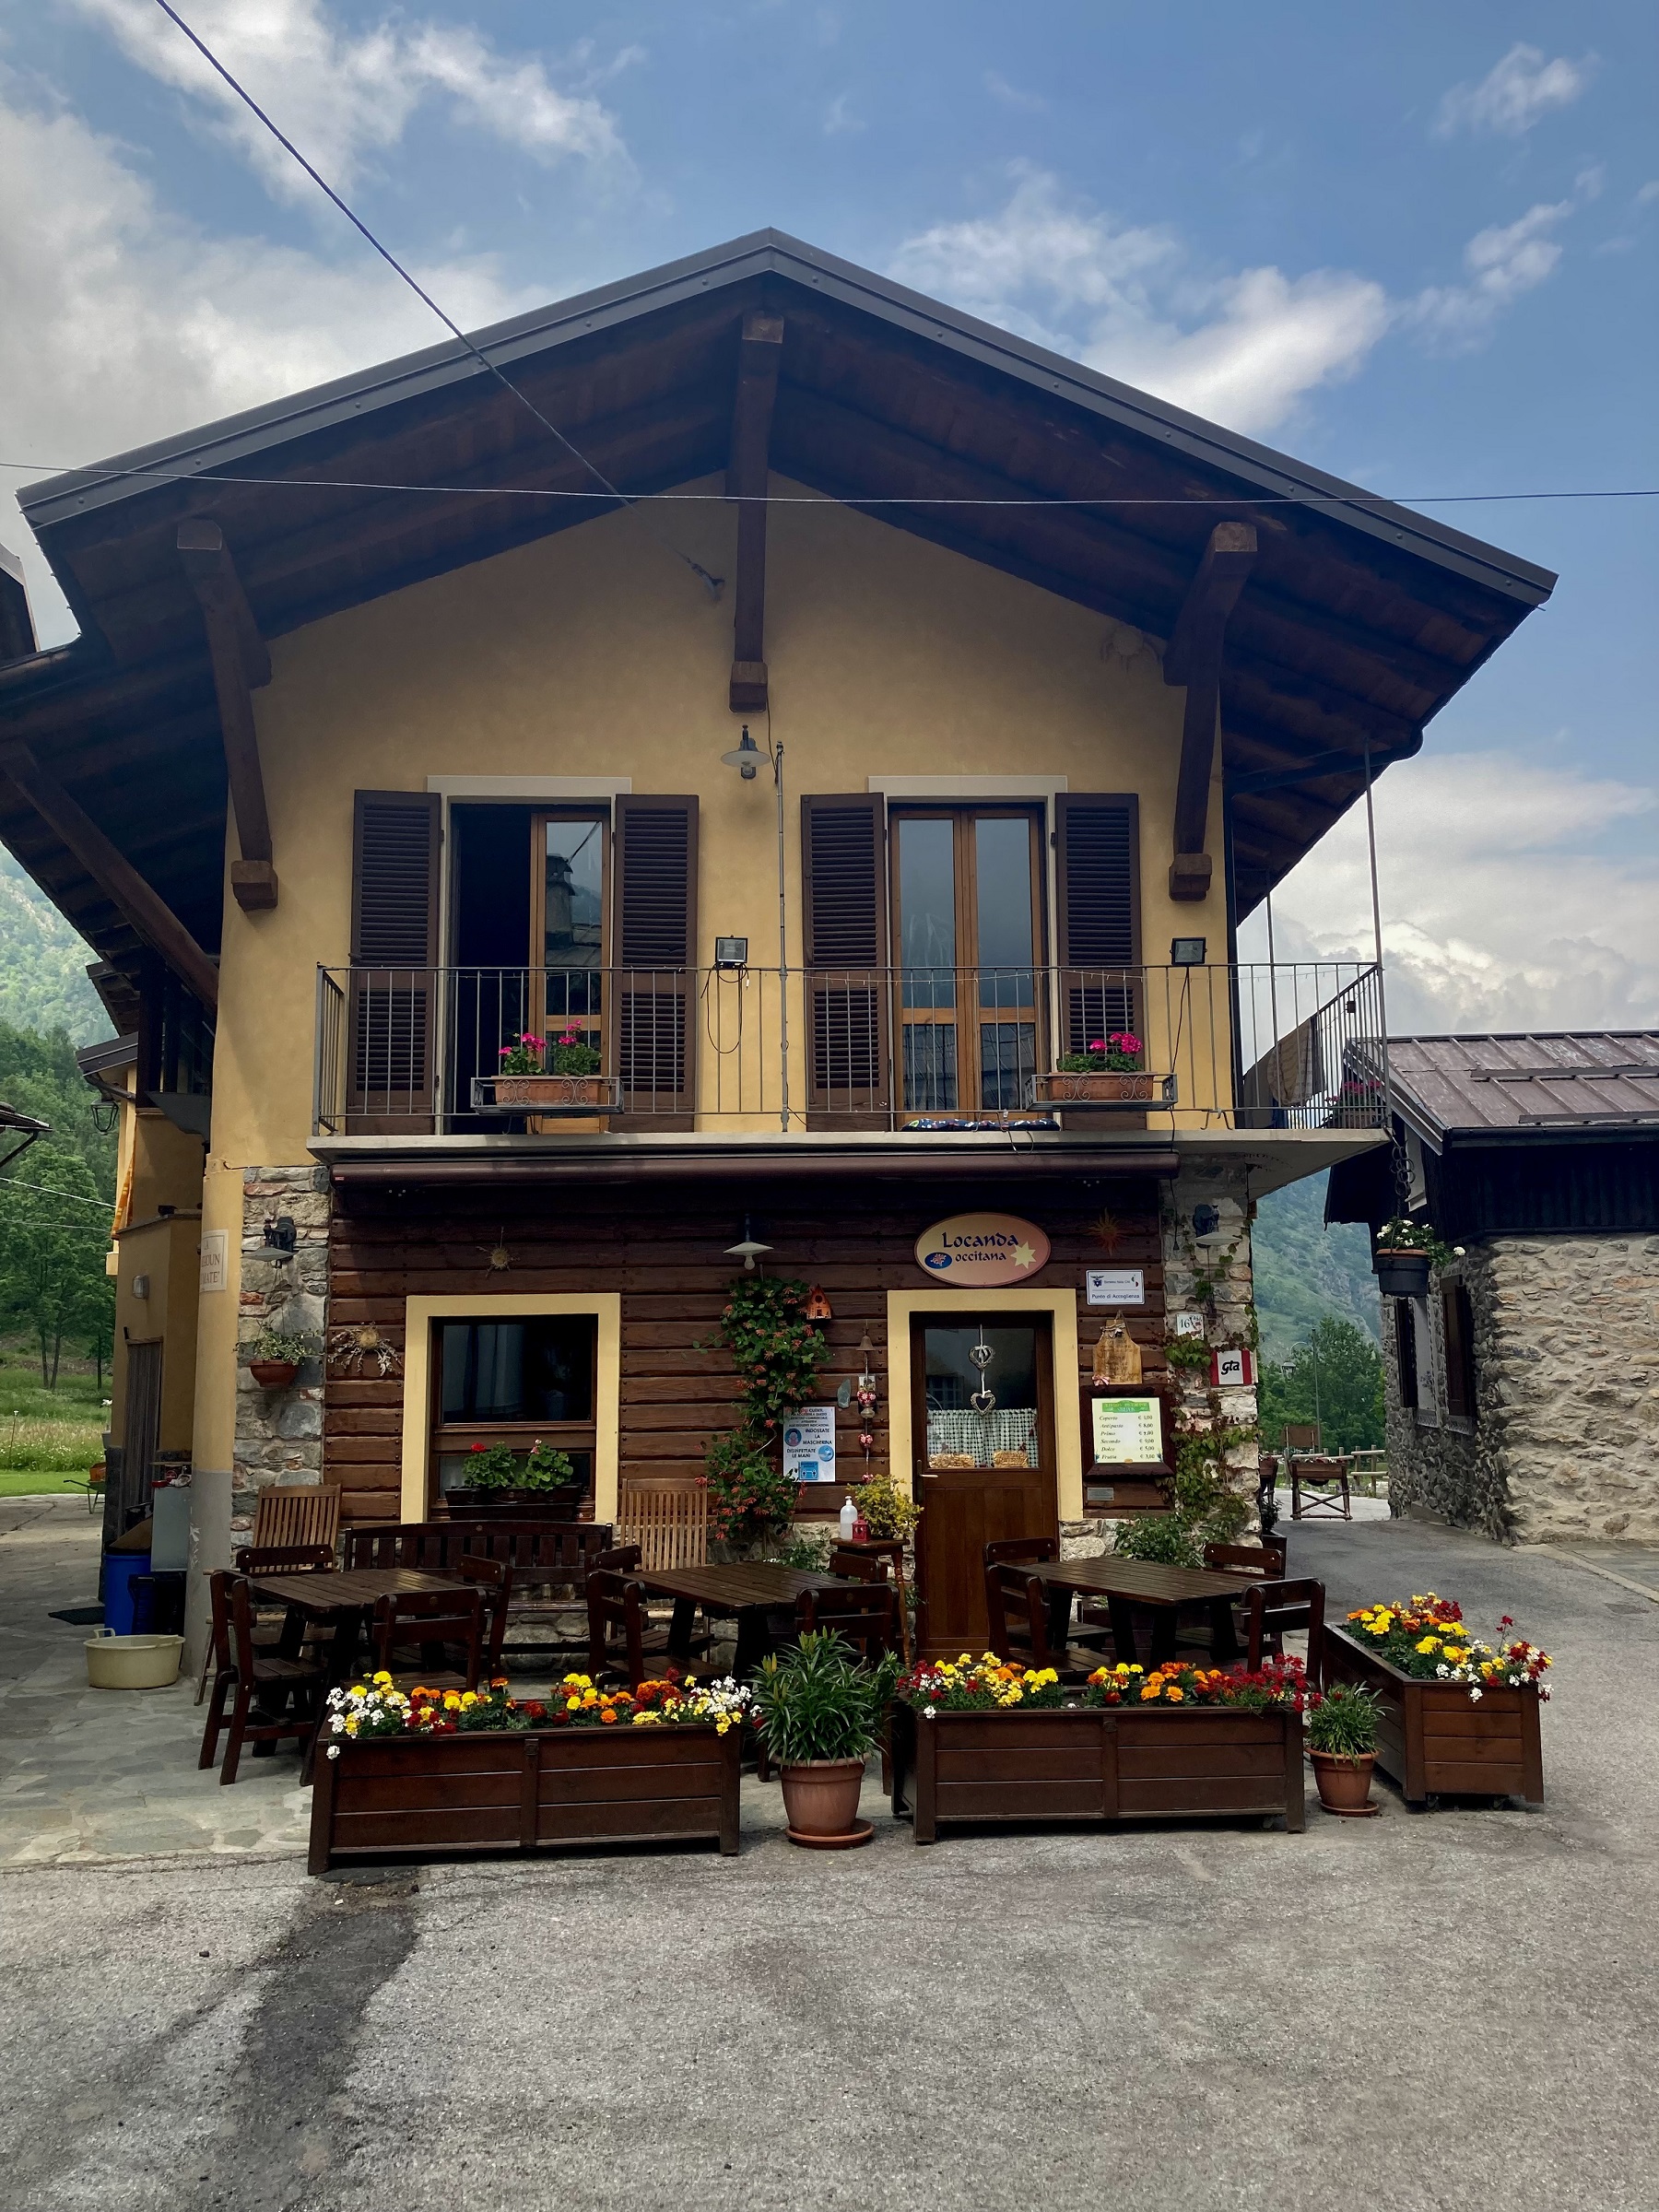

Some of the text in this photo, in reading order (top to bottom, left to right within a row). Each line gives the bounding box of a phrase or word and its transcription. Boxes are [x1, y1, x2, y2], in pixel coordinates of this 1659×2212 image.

[941, 1231, 1019, 1248] Locanda
[955, 1251, 1007, 1262] occitana
[1180, 1318, 1191, 1329] 16
[1220, 1359, 1241, 1376] gta
